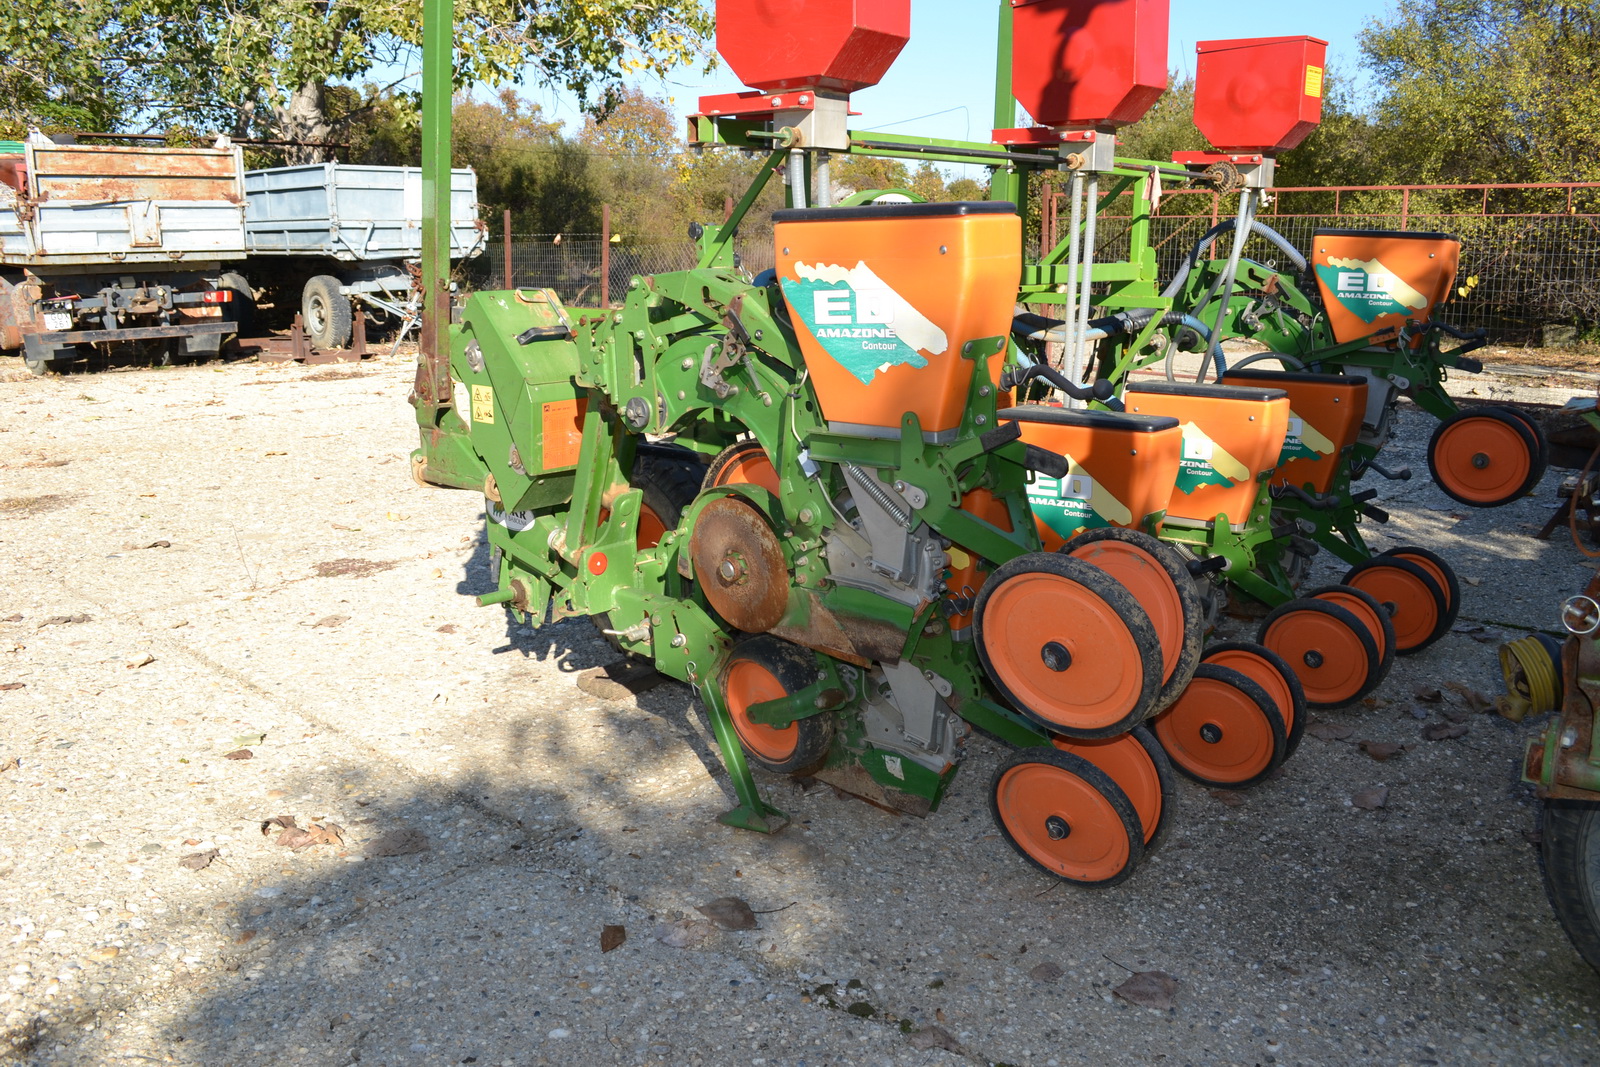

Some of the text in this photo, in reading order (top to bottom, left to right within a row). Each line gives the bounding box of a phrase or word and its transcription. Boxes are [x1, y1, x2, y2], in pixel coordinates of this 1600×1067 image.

[1337, 271, 1394, 292] ED
[1337, 292, 1393, 300] AMAZONE
[813, 289, 895, 325] ED
[816, 328, 896, 338] AMAZONE
[862, 341, 897, 350] Contour
[1184, 439, 1213, 460] D
[1179, 460, 1213, 469] ZONE
[1186, 468, 1214, 477] Contour
[1026, 469, 1092, 500] ED
[1028, 497, 1093, 511] AMAZONE
[1063, 509, 1093, 519] Contour
